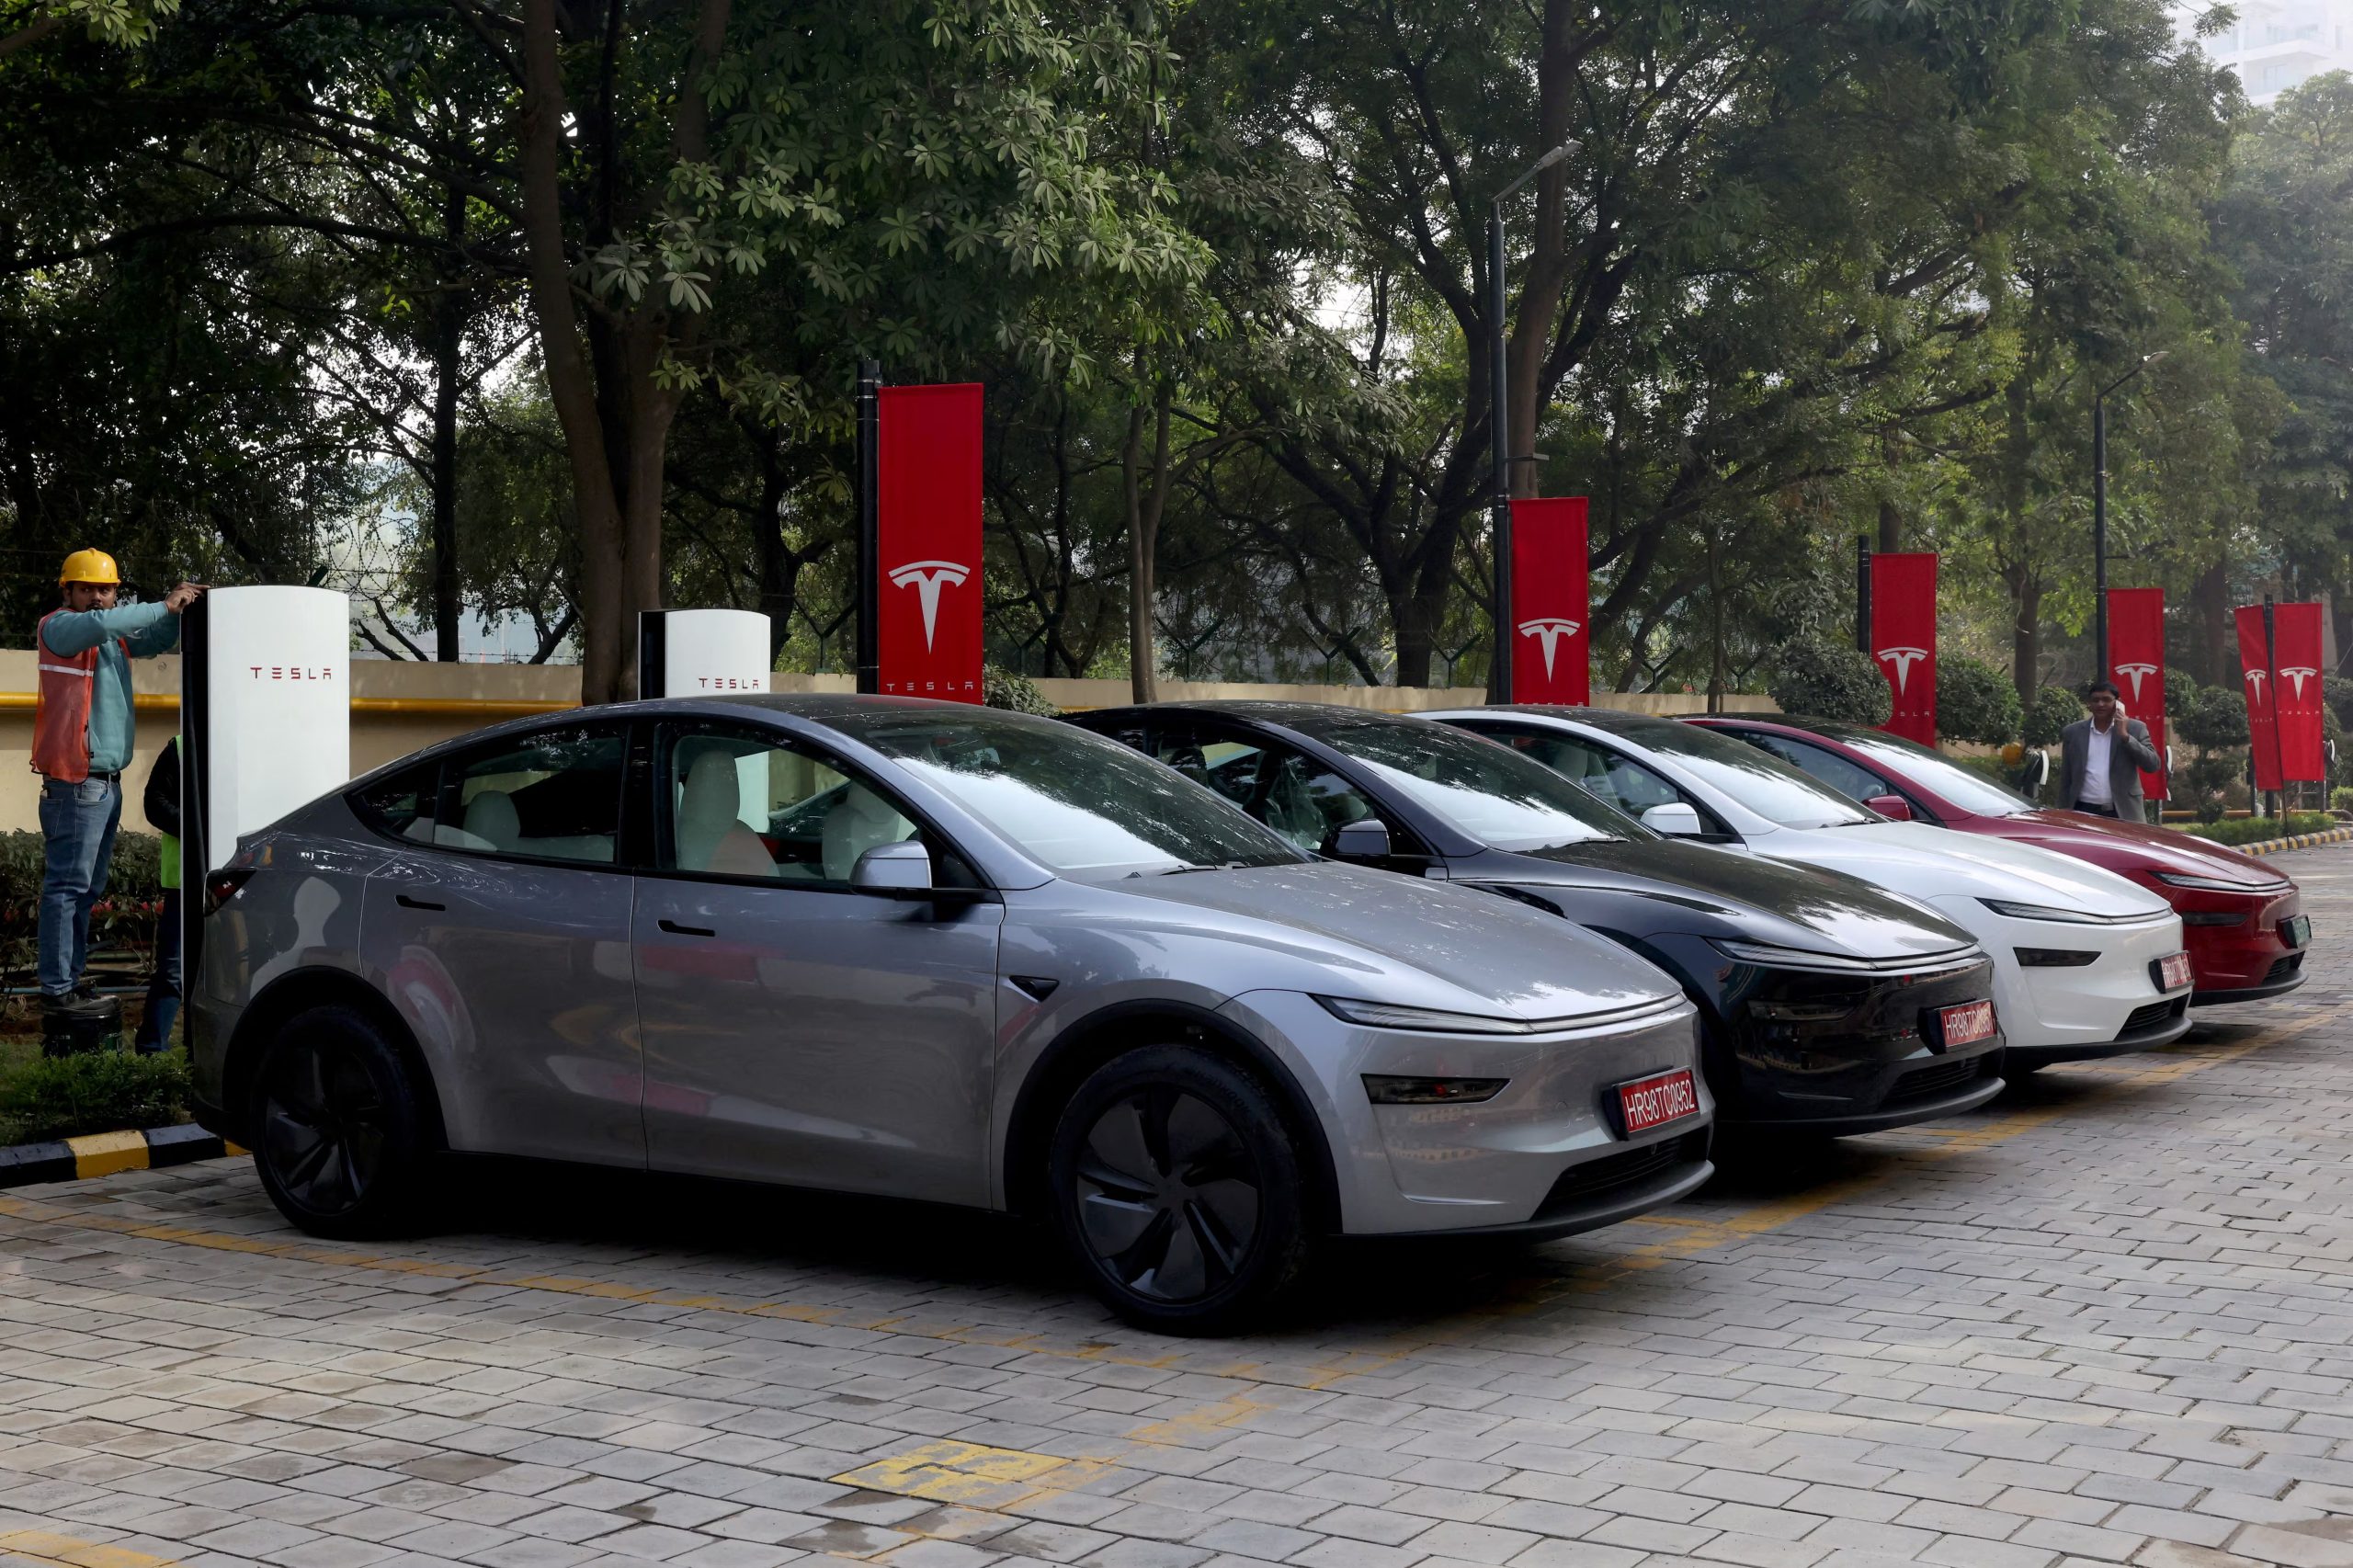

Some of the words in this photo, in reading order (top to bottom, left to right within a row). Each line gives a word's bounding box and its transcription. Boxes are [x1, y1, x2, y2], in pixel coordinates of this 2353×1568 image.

[250, 667, 332, 680] TESLA
[699, 678, 759, 689] TESLA
[886, 681, 974, 692] TESLA
[1625, 1079, 1695, 1127] HR98TC0952
